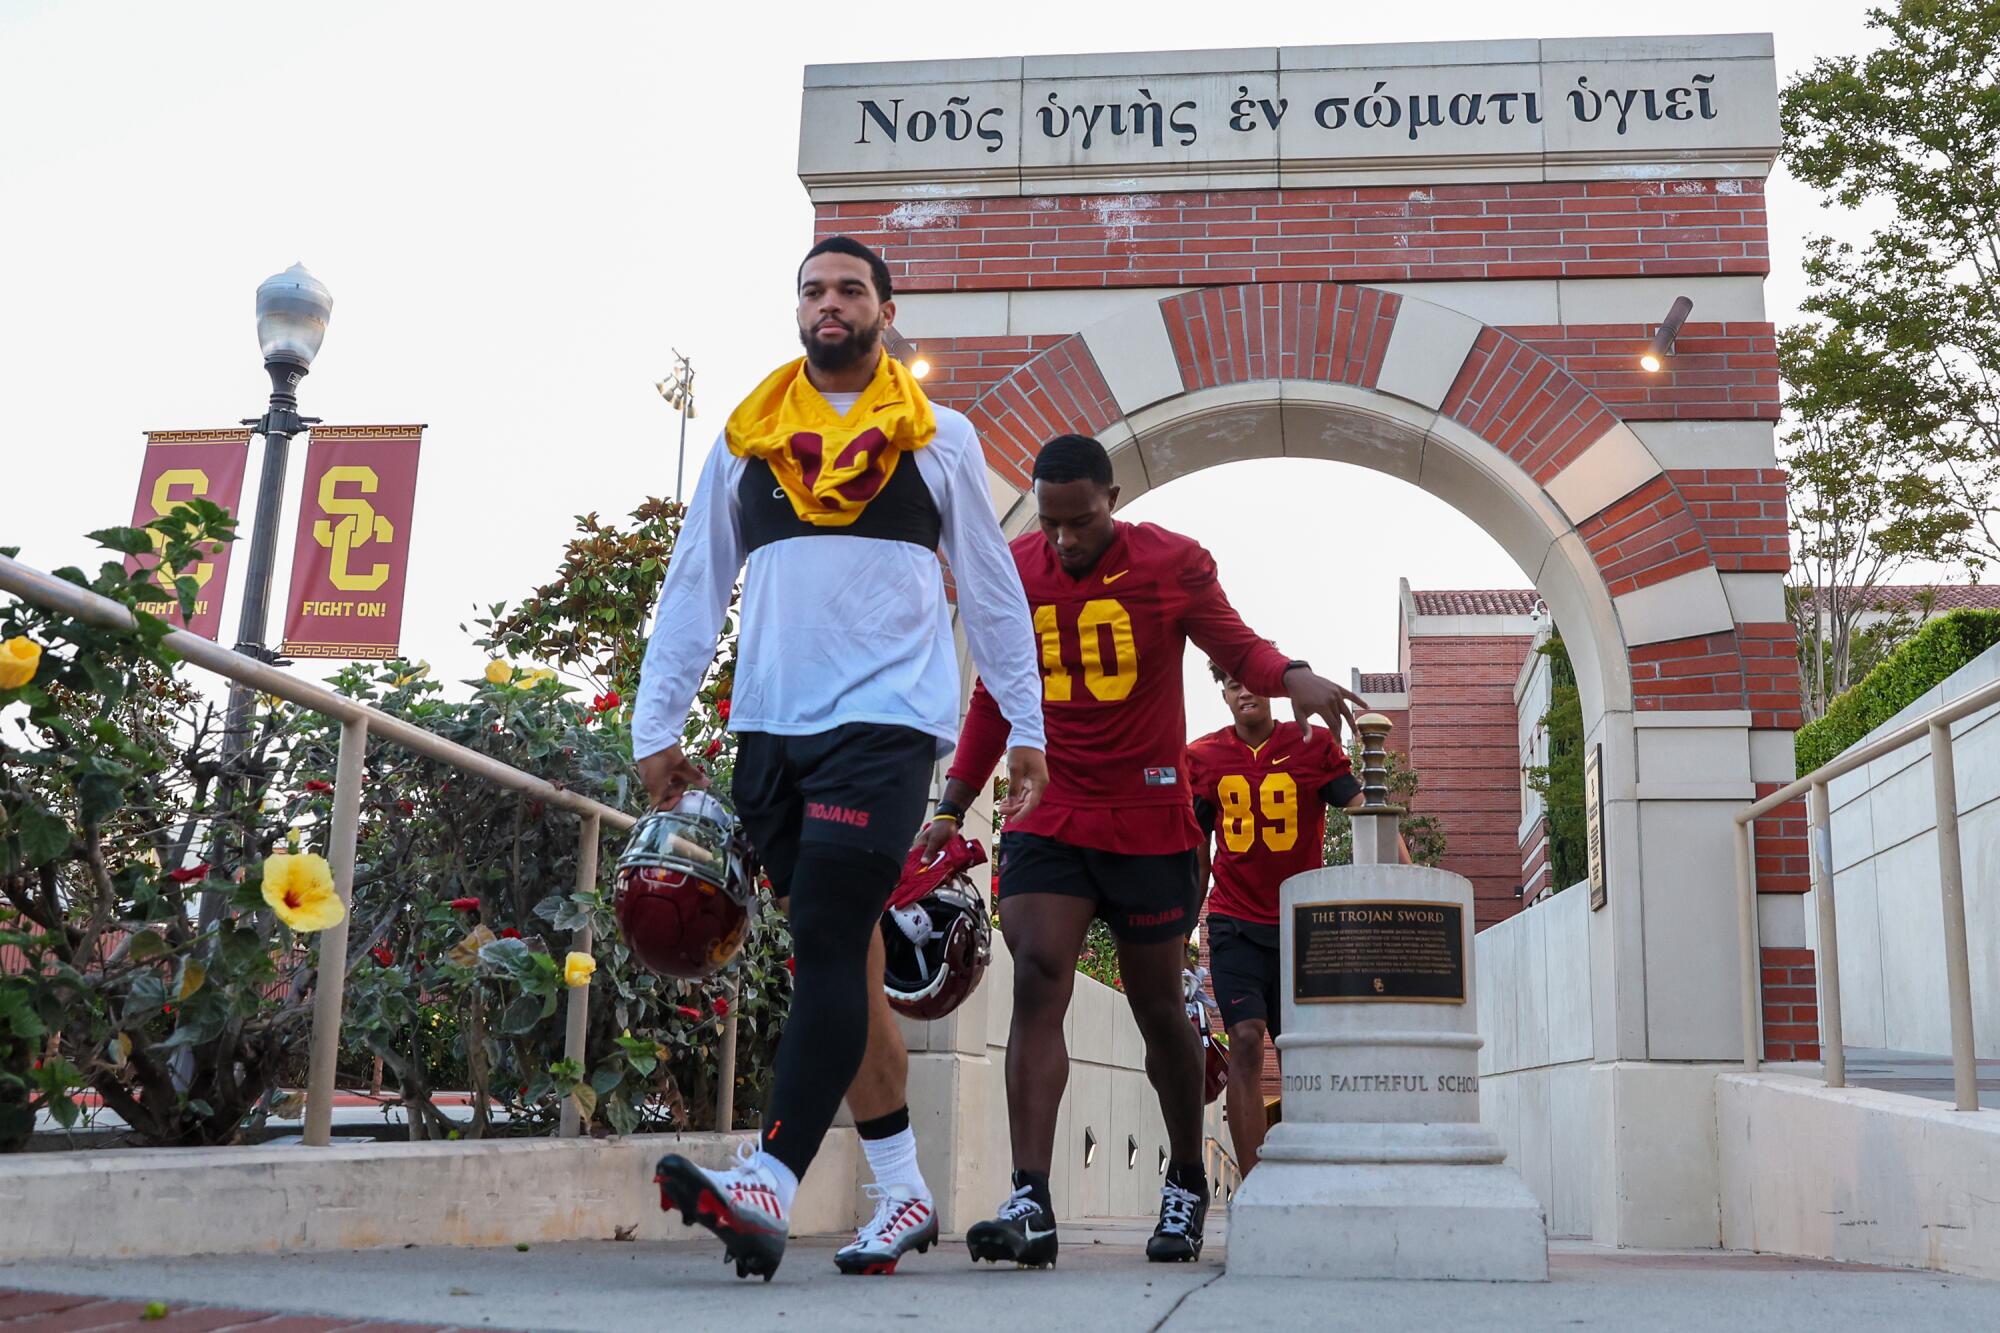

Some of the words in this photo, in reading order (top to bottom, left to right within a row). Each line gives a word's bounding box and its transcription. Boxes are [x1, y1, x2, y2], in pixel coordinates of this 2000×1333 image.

[854, 96, 1004, 153] Νοῦς
[1035, 88, 1198, 150] ὑγιὴς
[1229, 85, 1288, 132] ἐν
[1314, 81, 1543, 141] σώματι
[1566, 73, 1718, 135] ὑγιεῖ
[302, 601, 354, 617] FIGHT
[357, 602, 386, 617] ON!
[1033, 598, 1138, 702] 10
[1217, 772, 1298, 852] 89
[1312, 911, 1336, 924] THE
[1338, 910, 1393, 925] TROJAN
[1397, 910, 1444, 923] SWORD
[1330, 1074, 1429, 1092] FAITHFUL
